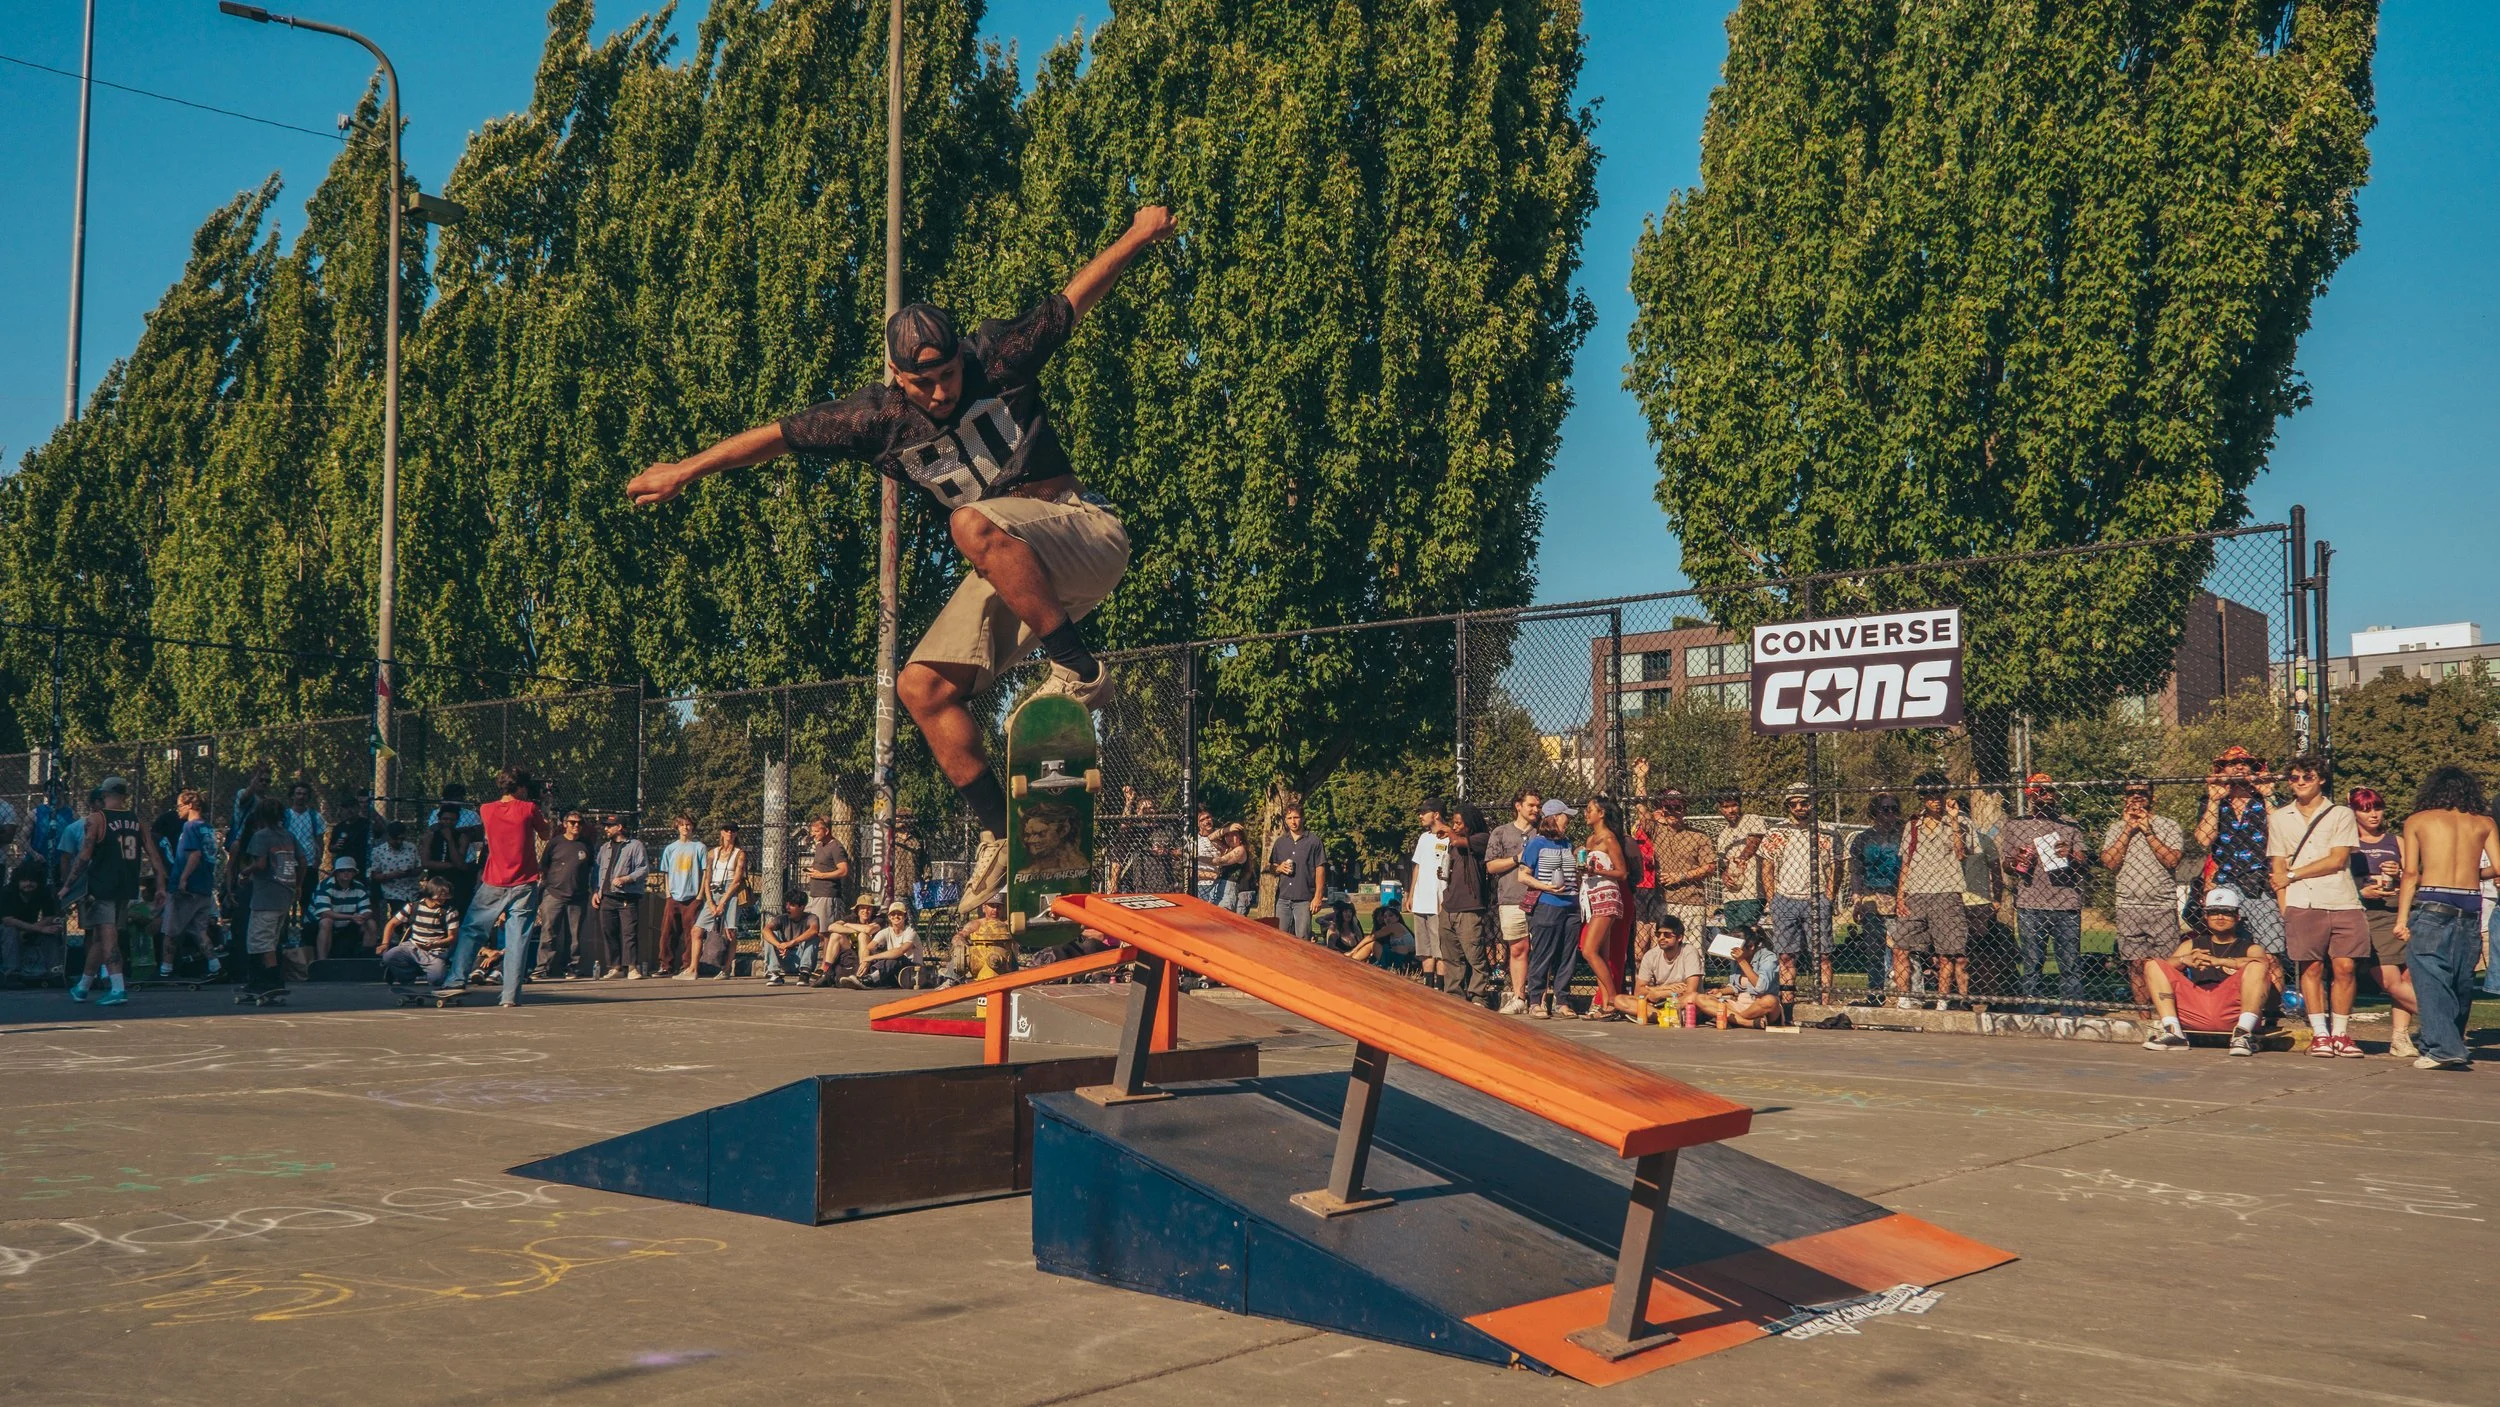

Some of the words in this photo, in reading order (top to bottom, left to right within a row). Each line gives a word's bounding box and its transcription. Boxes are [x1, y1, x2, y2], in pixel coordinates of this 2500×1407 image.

[899, 398, 1025, 504] 80
[1760, 617, 1952, 656] CONVERSE
[1760, 660, 1953, 726] CONS
[117, 835, 137, 860] 13
